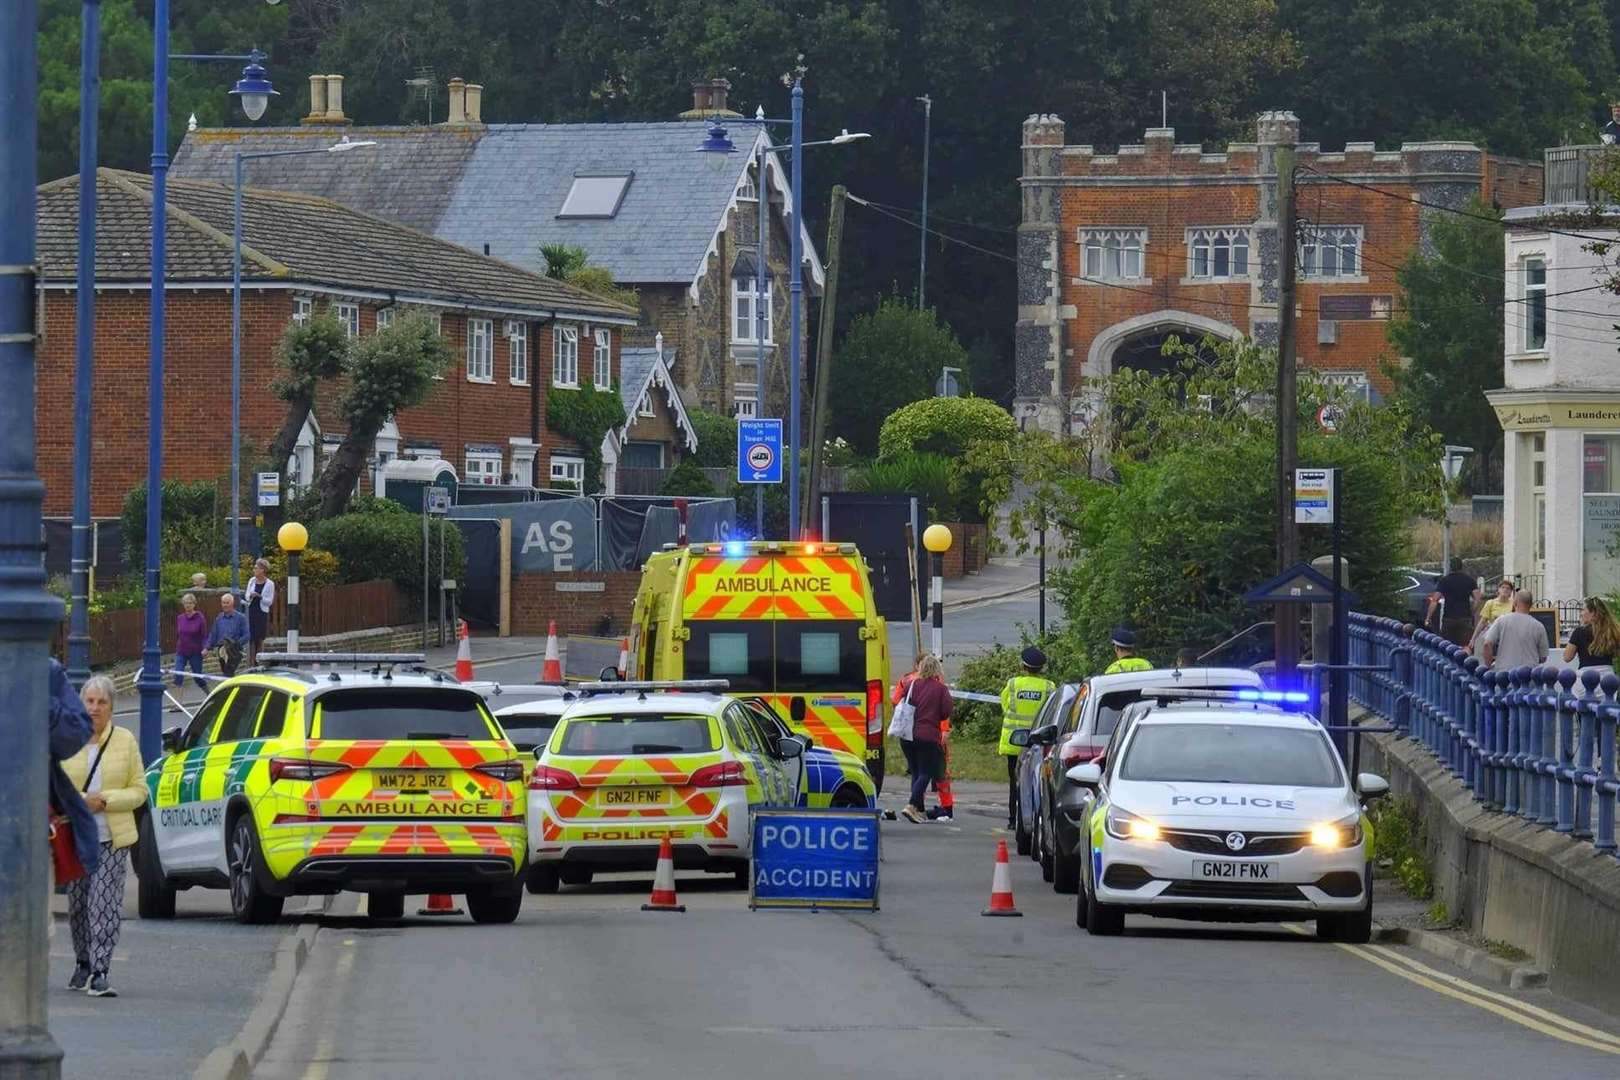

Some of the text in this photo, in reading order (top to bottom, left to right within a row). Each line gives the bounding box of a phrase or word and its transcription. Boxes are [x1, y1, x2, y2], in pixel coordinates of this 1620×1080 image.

[715, 577, 831, 593] AMBULANCE
[421, 775, 446, 787] JRZ
[606, 791, 662, 804] GN21 FNF
[1172, 795, 1295, 811] POLICE
[336, 802, 489, 815] AMBULANCE
[160, 808, 199, 827] CRITICAL
[582, 830, 686, 841] POLICE
[762, 825, 869, 850] POLICE
[756, 868, 875, 889] ACCIDENT
[1203, 862, 1269, 879] GN21 FNX
